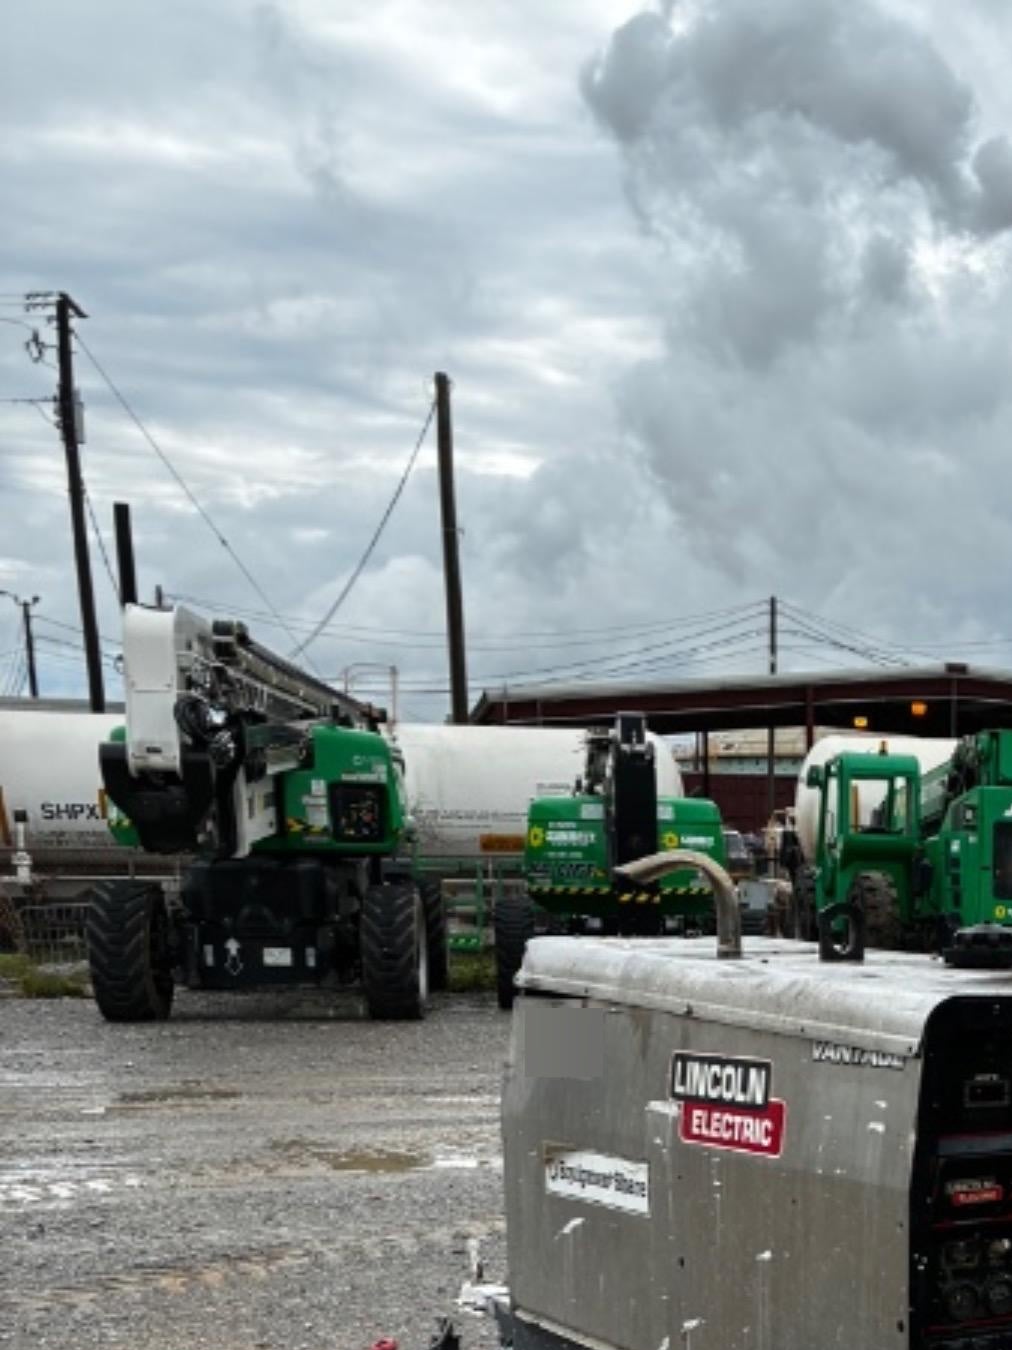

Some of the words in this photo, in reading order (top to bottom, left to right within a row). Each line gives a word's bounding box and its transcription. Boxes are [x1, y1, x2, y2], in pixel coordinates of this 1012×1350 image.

[41, 803, 99, 820] SHPX
[673, 1060, 766, 1105] LINCOLN
[691, 1109, 773, 1147] ELECTRIC
